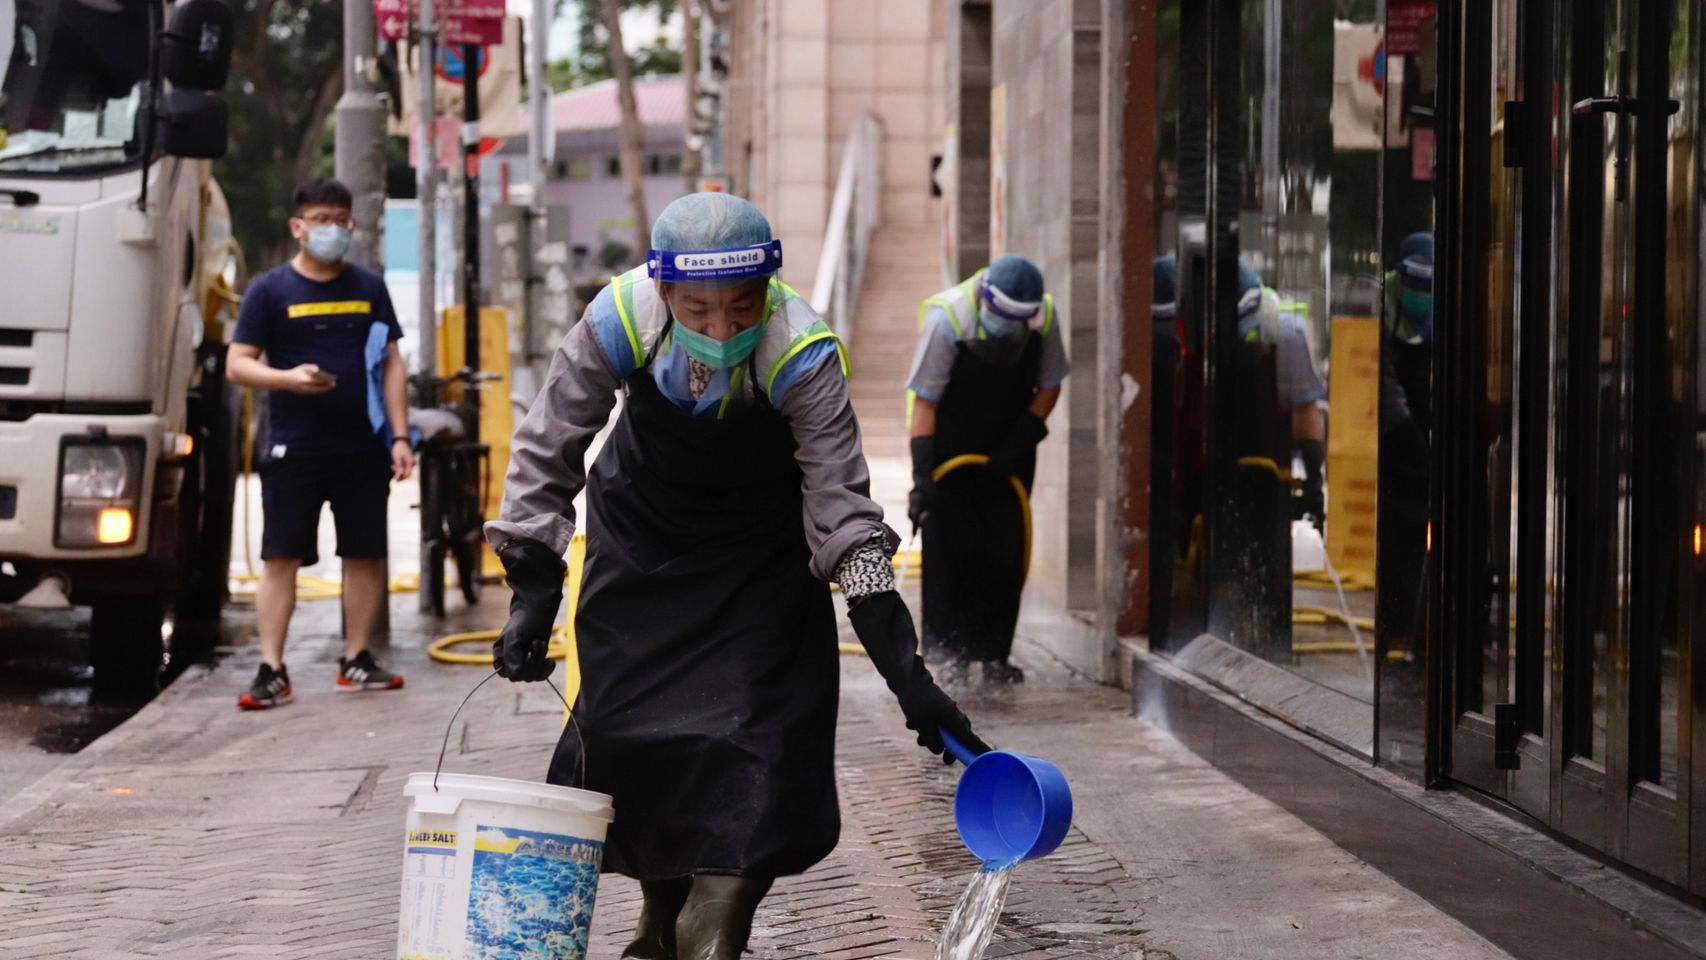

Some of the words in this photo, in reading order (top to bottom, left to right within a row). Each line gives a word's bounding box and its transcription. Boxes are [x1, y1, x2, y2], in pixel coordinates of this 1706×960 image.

[684, 257, 715, 267] Face
[720, 252, 758, 265] shield
[432, 832, 456, 843] SALT
